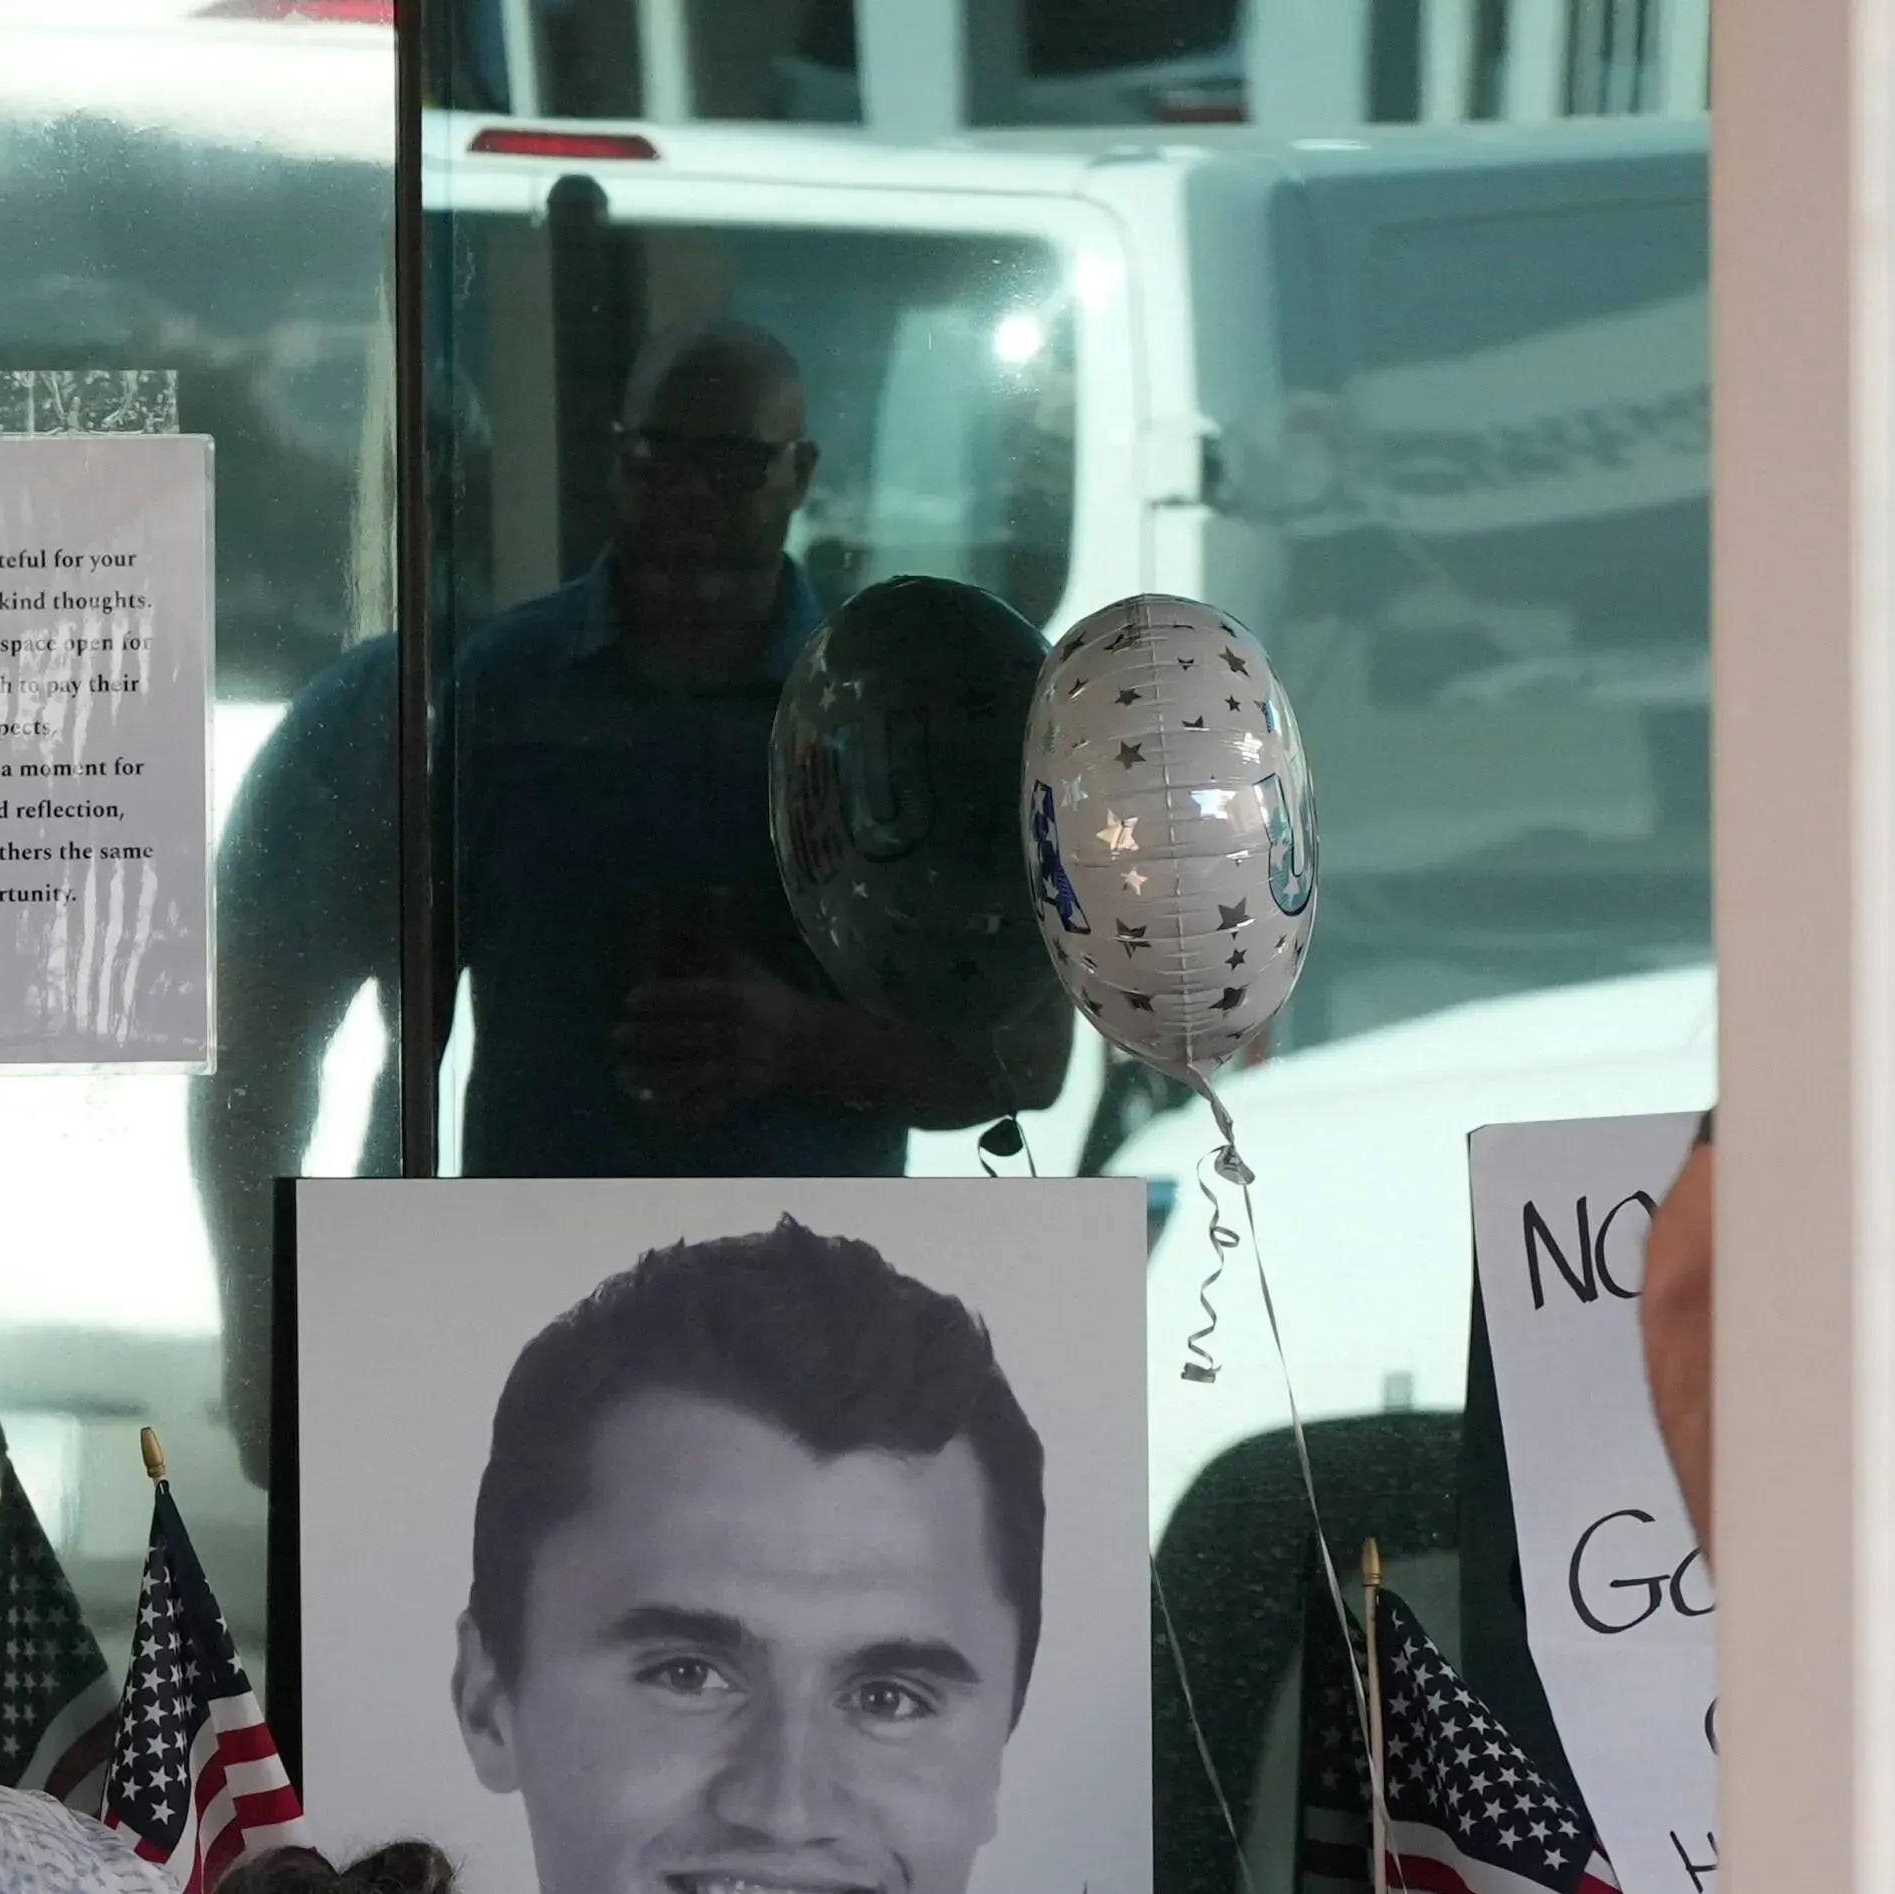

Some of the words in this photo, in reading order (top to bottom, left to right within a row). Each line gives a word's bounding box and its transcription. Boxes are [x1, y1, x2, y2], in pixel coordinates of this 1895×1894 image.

[54, 549, 85, 569] for
[90, 554, 138, 574] your
[53, 590, 153, 615] thoughts.
[0, 638, 58, 658] space
[67, 636, 114, 657] open
[122, 630, 153, 652] for
[20, 677, 40, 694] to
[50, 681, 82, 699] pay
[90, 673, 140, 693] their
[1, 764, 13, 778] a
[20, 760, 107, 778] moment
[114, 757, 146, 776] for
[17, 799, 125, 821] reflection,
[60, 841, 93, 860] the
[100, 846, 154, 860] same
